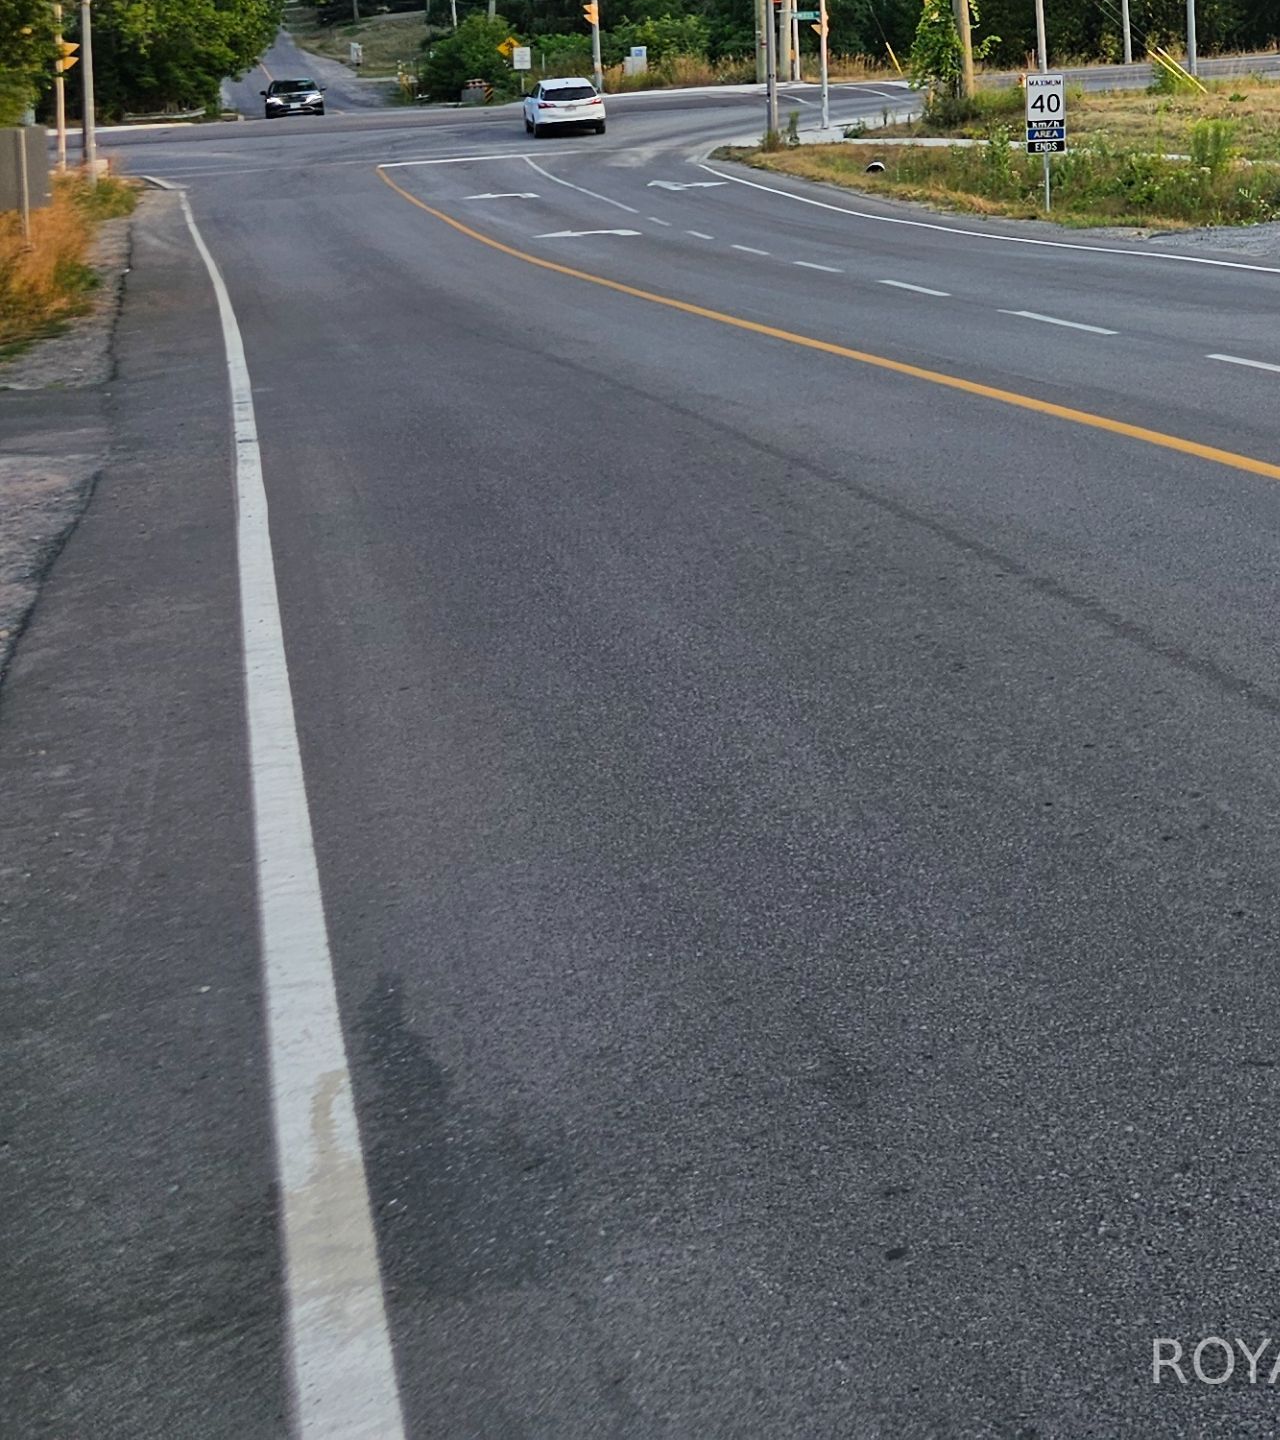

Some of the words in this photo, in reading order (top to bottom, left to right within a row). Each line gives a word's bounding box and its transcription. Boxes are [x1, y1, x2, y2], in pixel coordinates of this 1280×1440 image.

[1031, 94, 1060, 113] 40
[1034, 130, 1059, 138] AREA
[1035, 142, 1058, 151] ENDS
